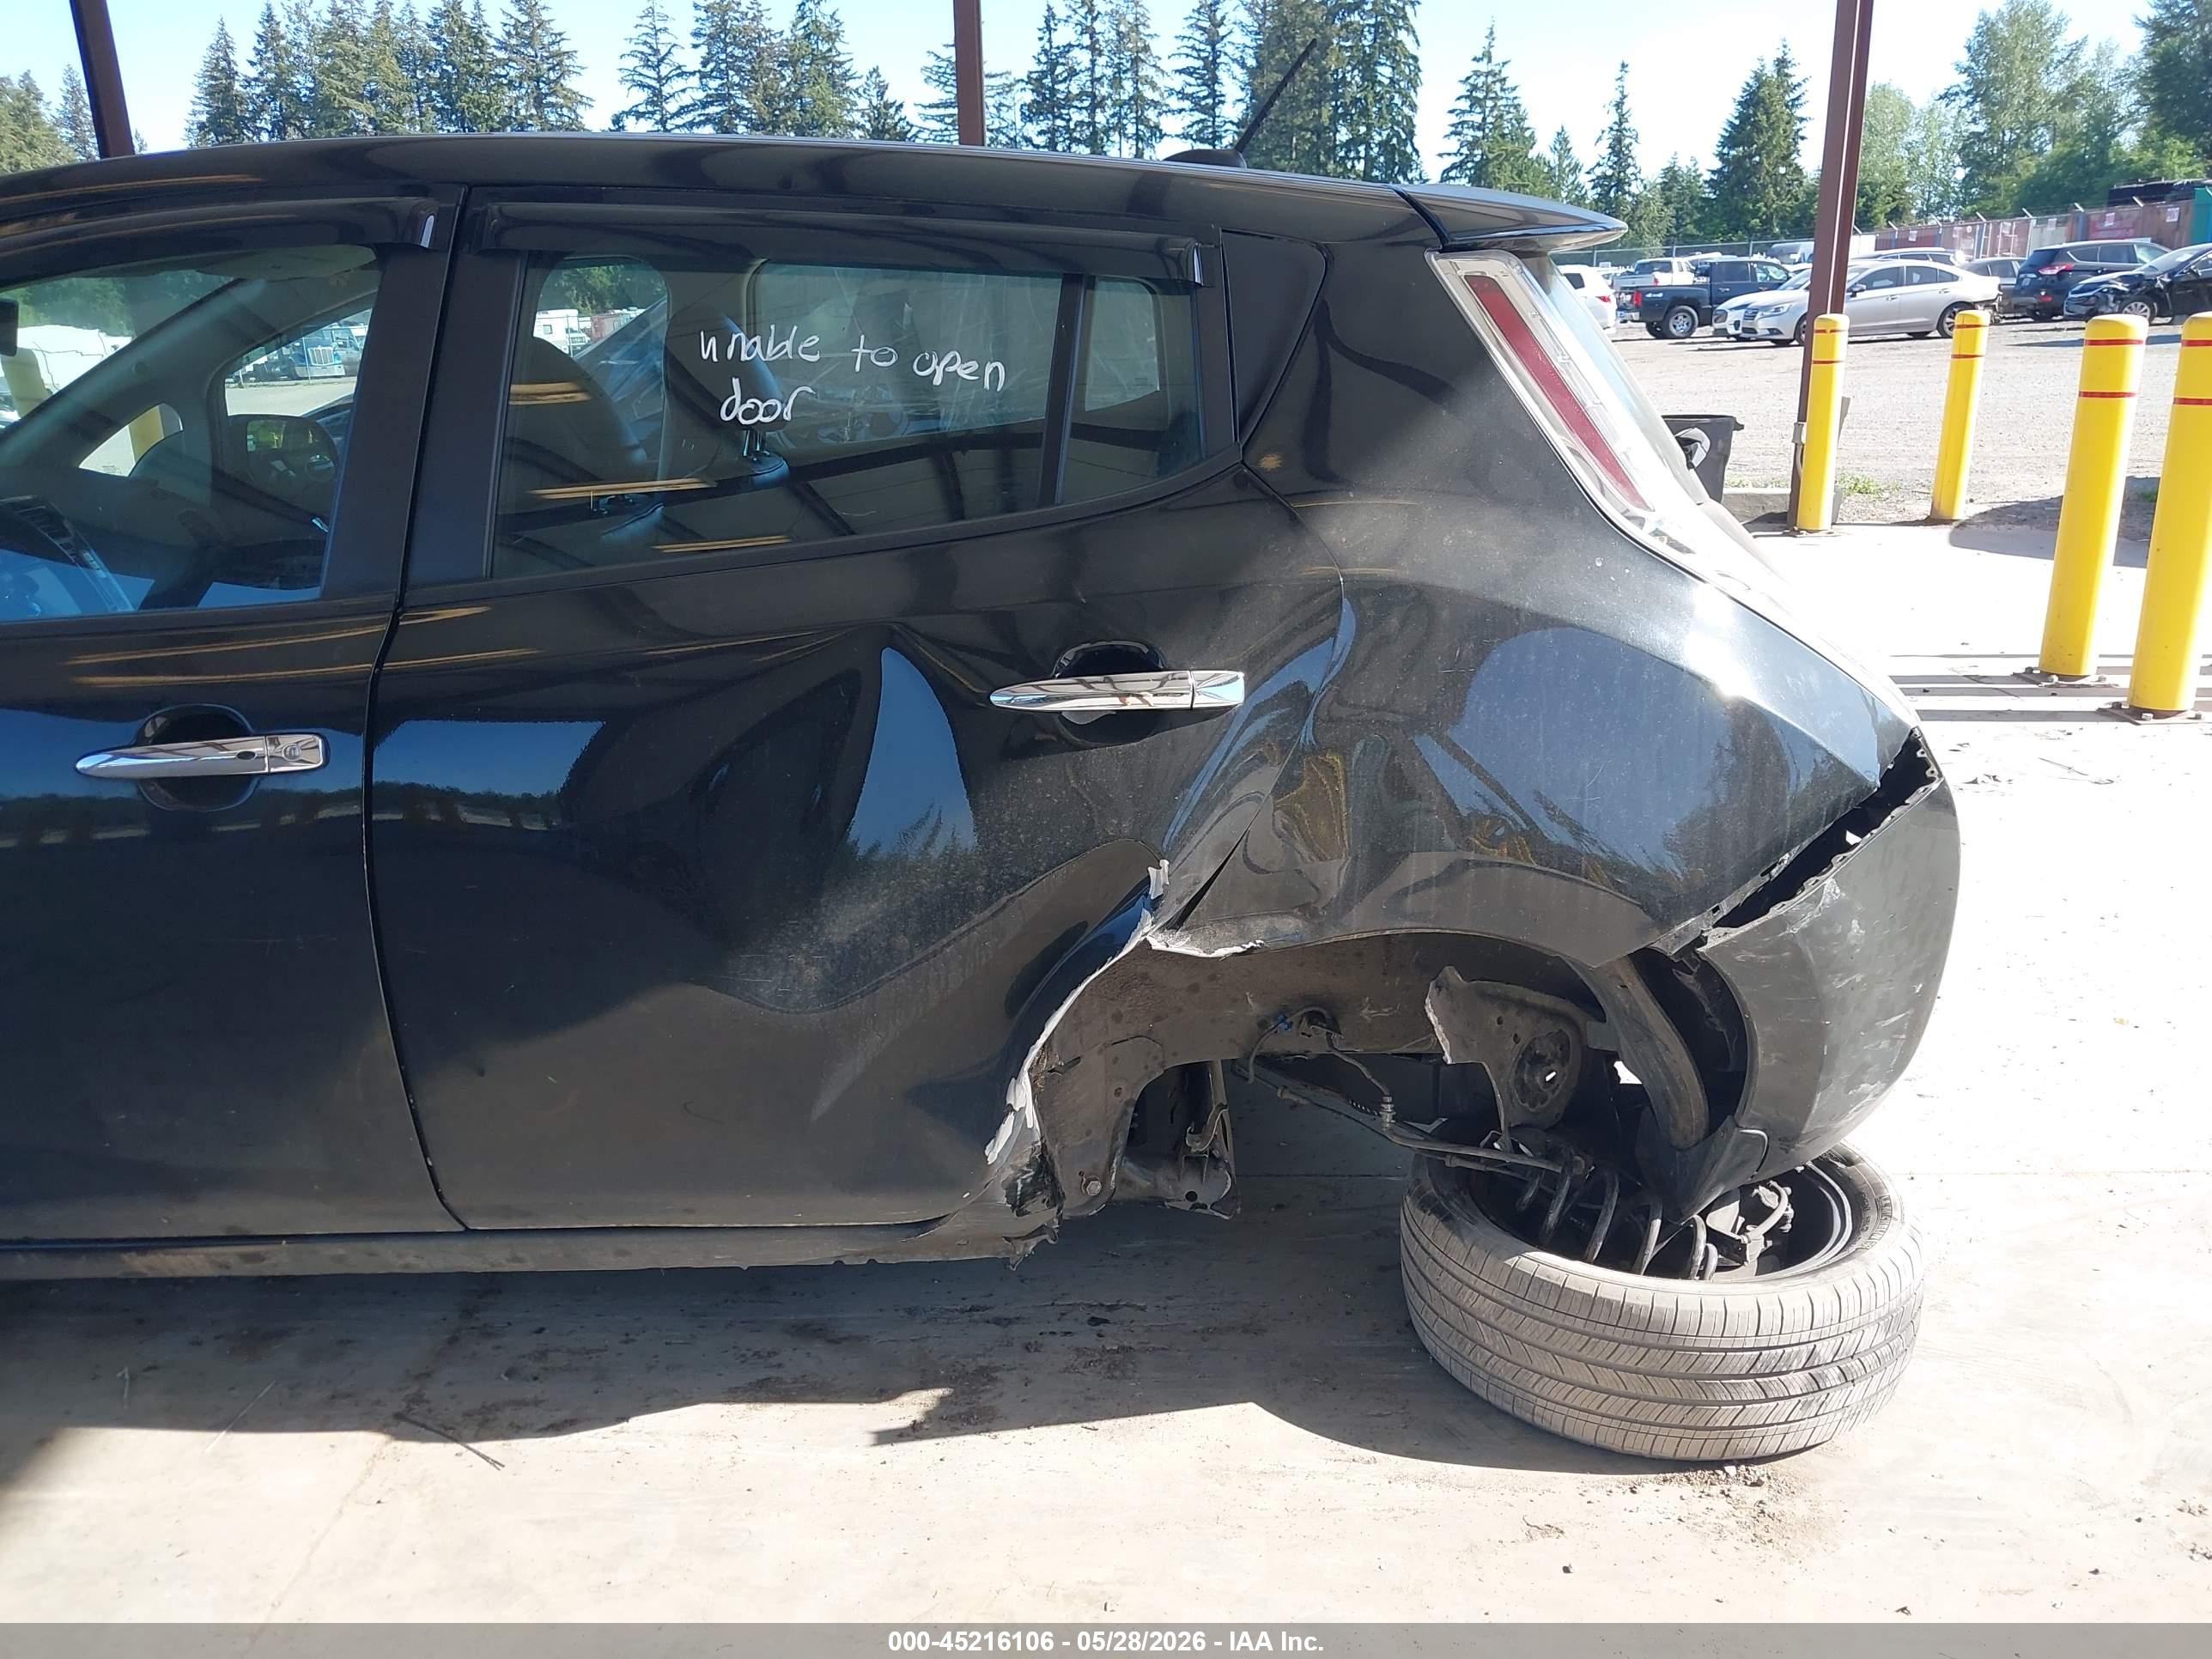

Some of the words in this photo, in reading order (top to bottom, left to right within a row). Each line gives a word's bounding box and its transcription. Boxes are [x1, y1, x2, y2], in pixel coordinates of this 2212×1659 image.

[699, 324, 821, 362] unable
[851, 334, 897, 372] to
[913, 350, 1006, 392] open
[720, 378, 817, 424] door
